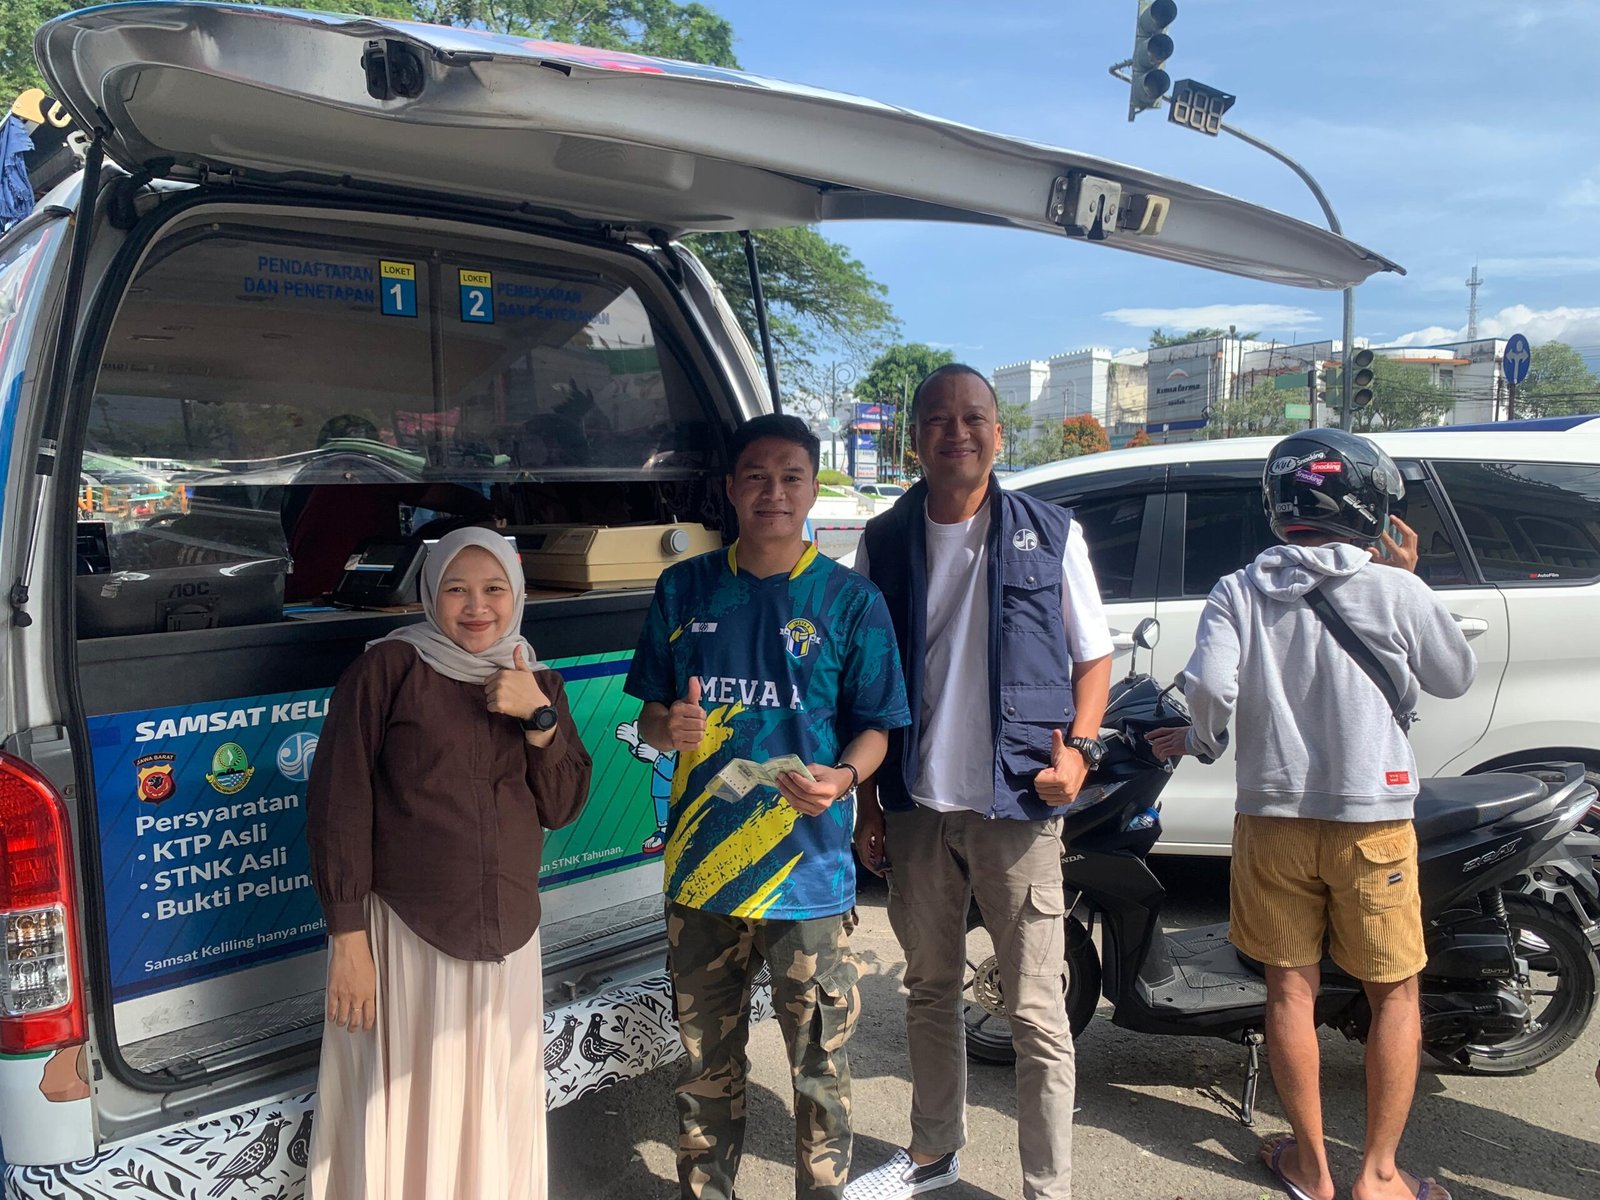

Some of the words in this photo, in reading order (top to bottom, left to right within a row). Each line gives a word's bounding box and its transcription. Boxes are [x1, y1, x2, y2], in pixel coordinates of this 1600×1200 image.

[258, 256, 374, 283] PENDAFTARAN
[384, 266, 411, 276] LOKET
[463, 274, 488, 284] LOKET
[244, 277, 279, 294] DAN
[284, 281, 375, 303] PENETAPAN
[390, 283, 403, 311] 1
[469, 290, 485, 317] 2
[135, 706, 267, 742] SAMSAT
[136, 756, 153, 765] JAWA
[136, 794, 299, 837] Persyaratan
[153, 834, 212, 863] KTP
[218, 823, 267, 850] Asli
[155, 857, 234, 891] STNK
[239, 847, 287, 874] Asli
[552, 855, 580, 869] STNK
[582, 846, 624, 862] Tahunan.
[157, 886, 231, 921] Bukti
[238, 874, 314, 902] Pelun
[144, 950, 199, 972] Samsat
[201, 936, 254, 958] Keliling
[257, 928, 297, 944] hanya
